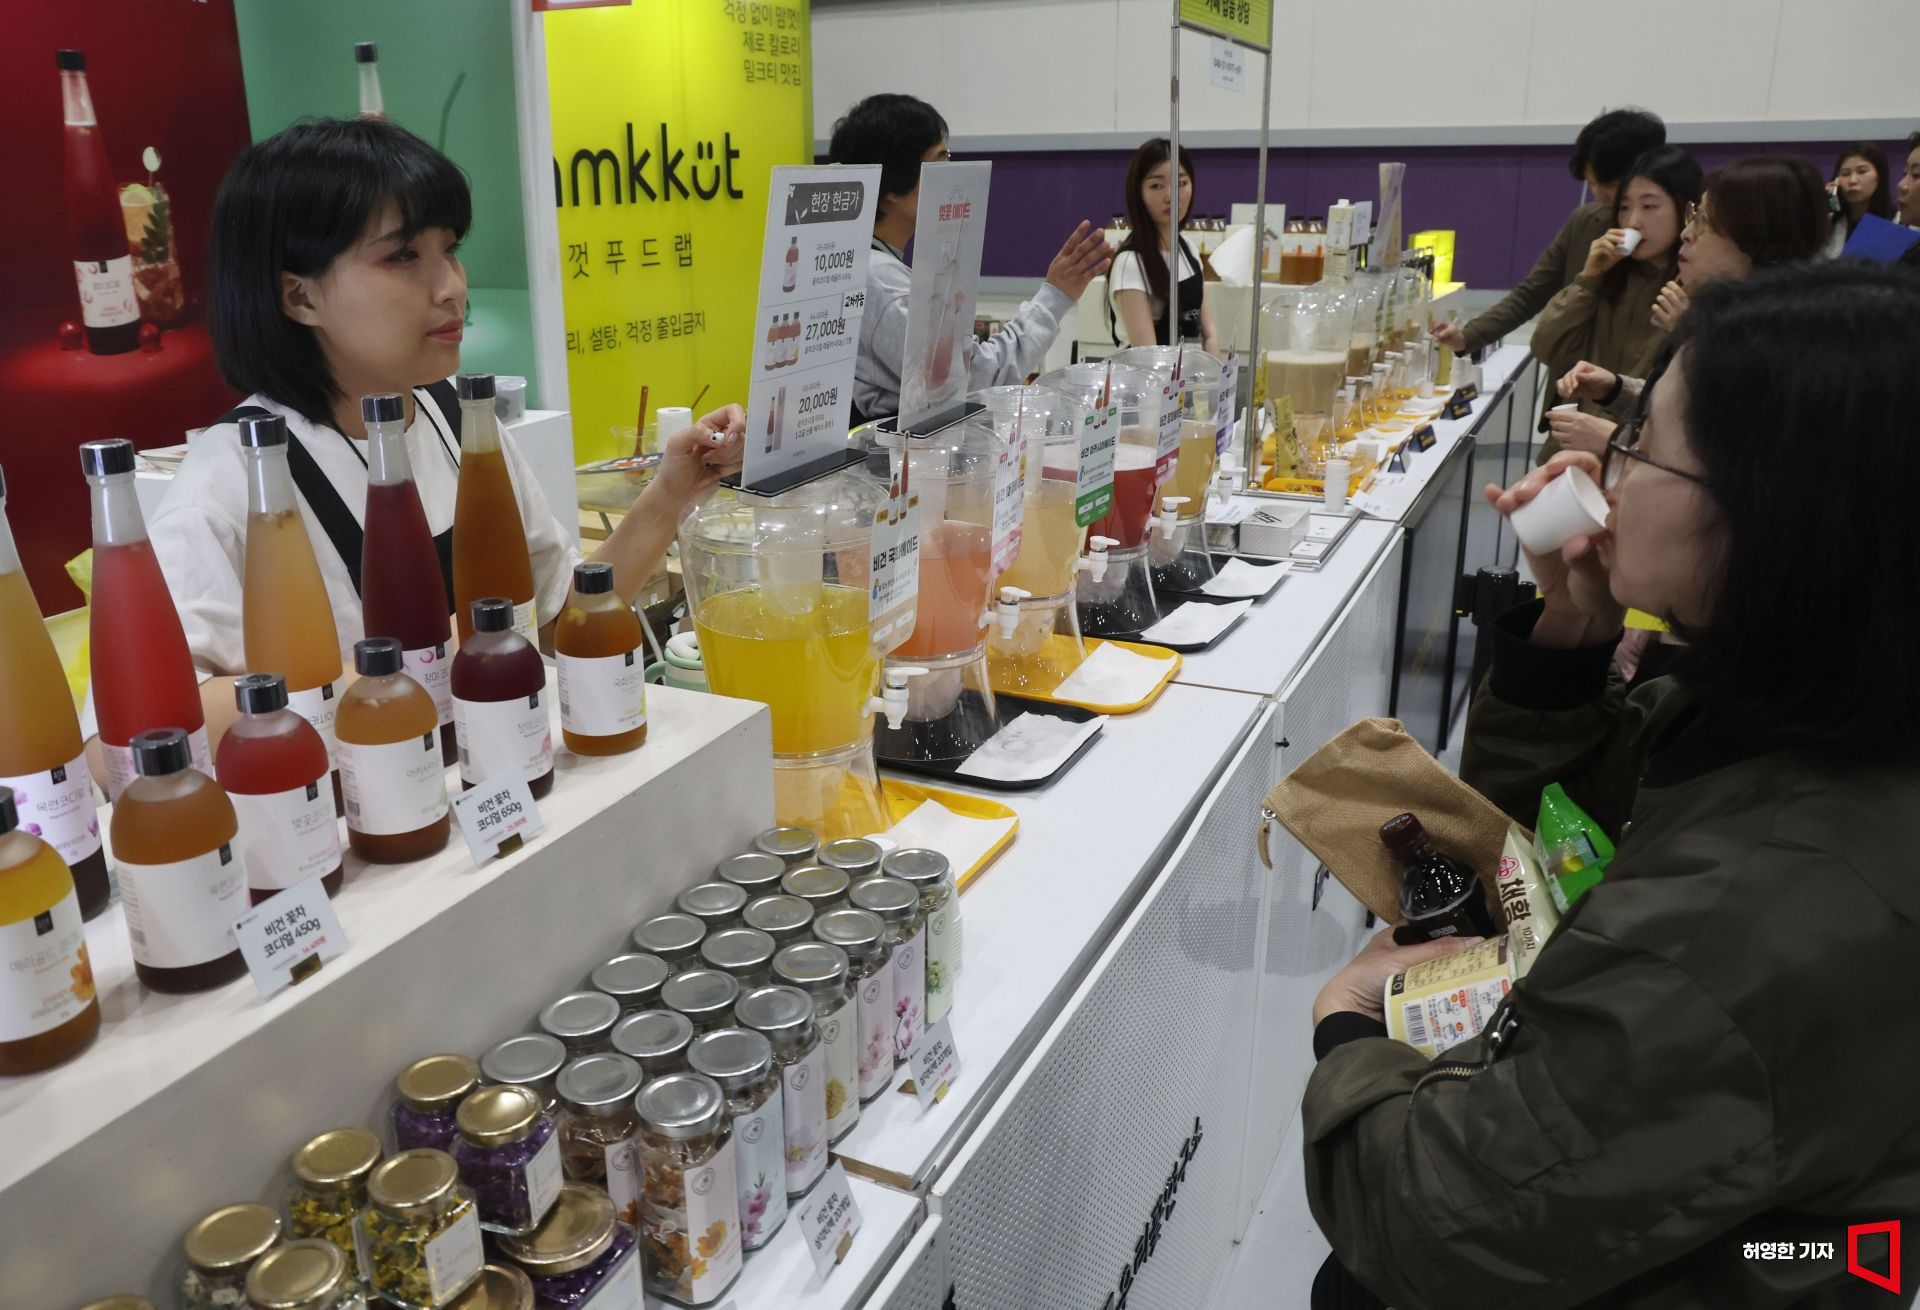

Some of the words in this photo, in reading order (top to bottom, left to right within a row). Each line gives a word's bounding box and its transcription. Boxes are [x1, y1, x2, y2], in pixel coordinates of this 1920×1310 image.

[750, 2, 772, 26] 없이
[742, 31, 766, 53] 제로
[768, 33, 800, 57] 칼로리
[744, 59, 777, 84] 밀크티
[780, 63, 801, 86] 맛집
[811, 192, 830, 213] 현장
[832, 190, 860, 212] 현금가
[814, 249, 856, 273] 10,000원
[590, 324, 622, 352] 설탕,
[626, 318, 653, 345] 걱정
[656, 310, 706, 341] 출입금지
[805, 317, 846, 341] 27,000원
[798, 386, 839, 415] 20,000원
[873, 551, 887, 573] 비건
[478, 797, 496, 814] 비건
[494, 788, 511, 807] 꽃차
[477, 810, 502, 832] 코디얼
[501, 801, 523, 818] 650g
[264, 917, 287, 936] 비건
[285, 904, 307, 925] 꽃차
[263, 931, 295, 958] 코디얼
[295, 918, 322, 938] 450g
